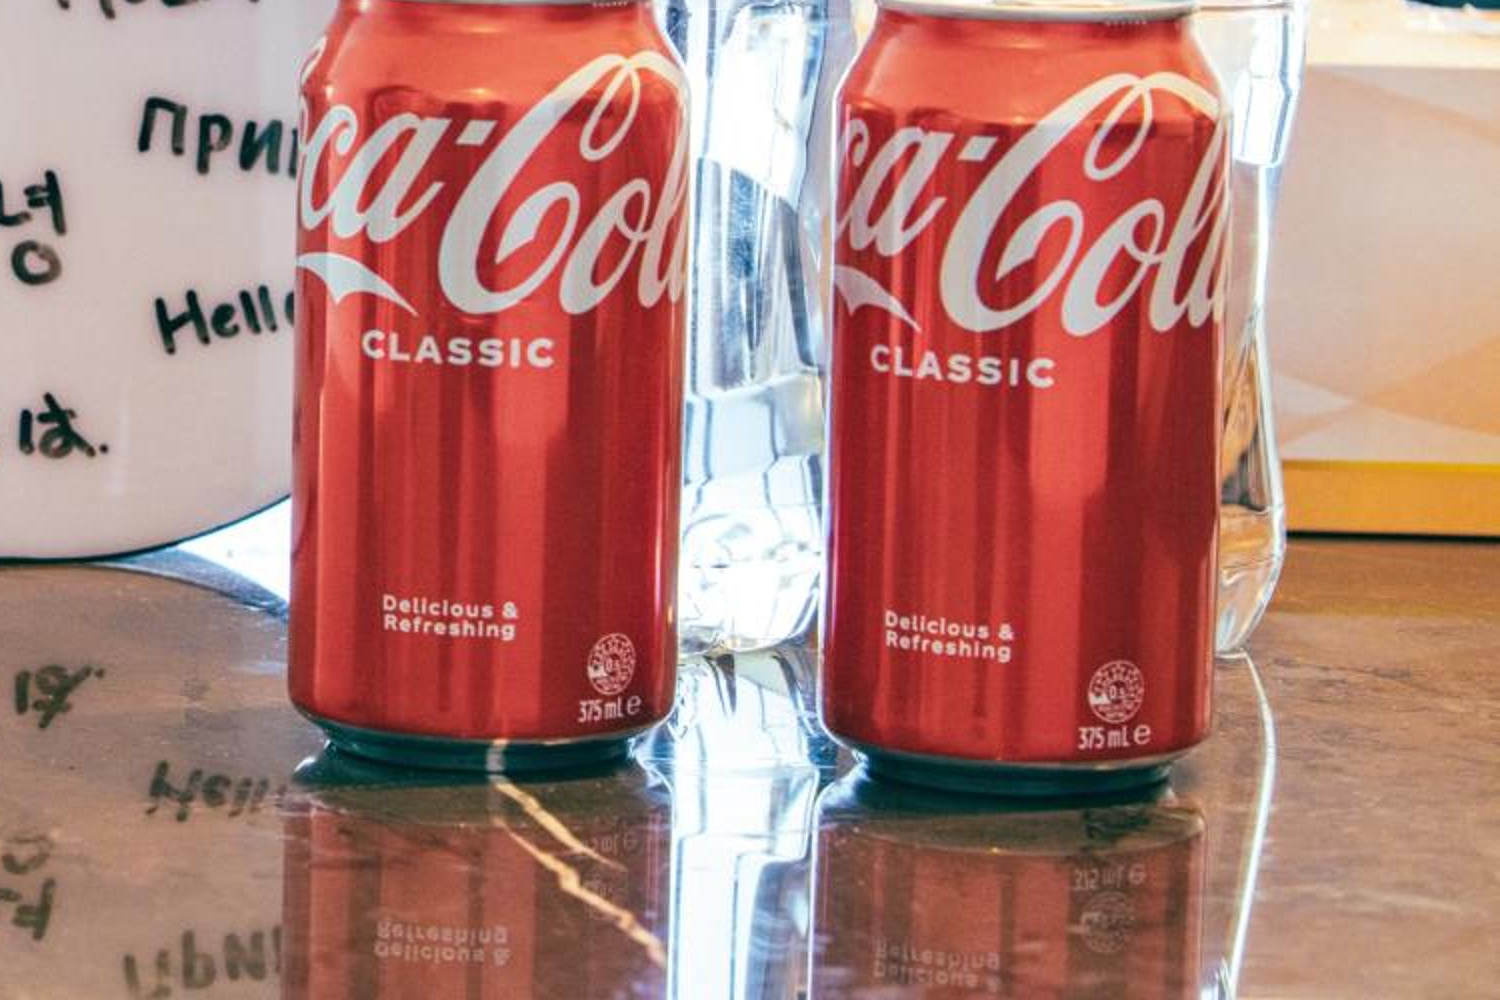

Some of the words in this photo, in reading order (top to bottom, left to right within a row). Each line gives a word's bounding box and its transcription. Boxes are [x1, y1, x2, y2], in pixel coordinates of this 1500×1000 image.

[137, 96, 298, 179] При
[154, 284, 296, 356] Hell
[361, 329, 555, 368] CLASSIC
[869, 343, 1056, 388] CLASSIC
[382, 594, 494, 619] Delicious
[500, 601, 519, 620] &
[383, 614, 517, 641] Refreshing
[884, 610, 991, 640] Delicious
[997, 622, 1015, 641] &
[884, 630, 1013, 662] Refreshing
